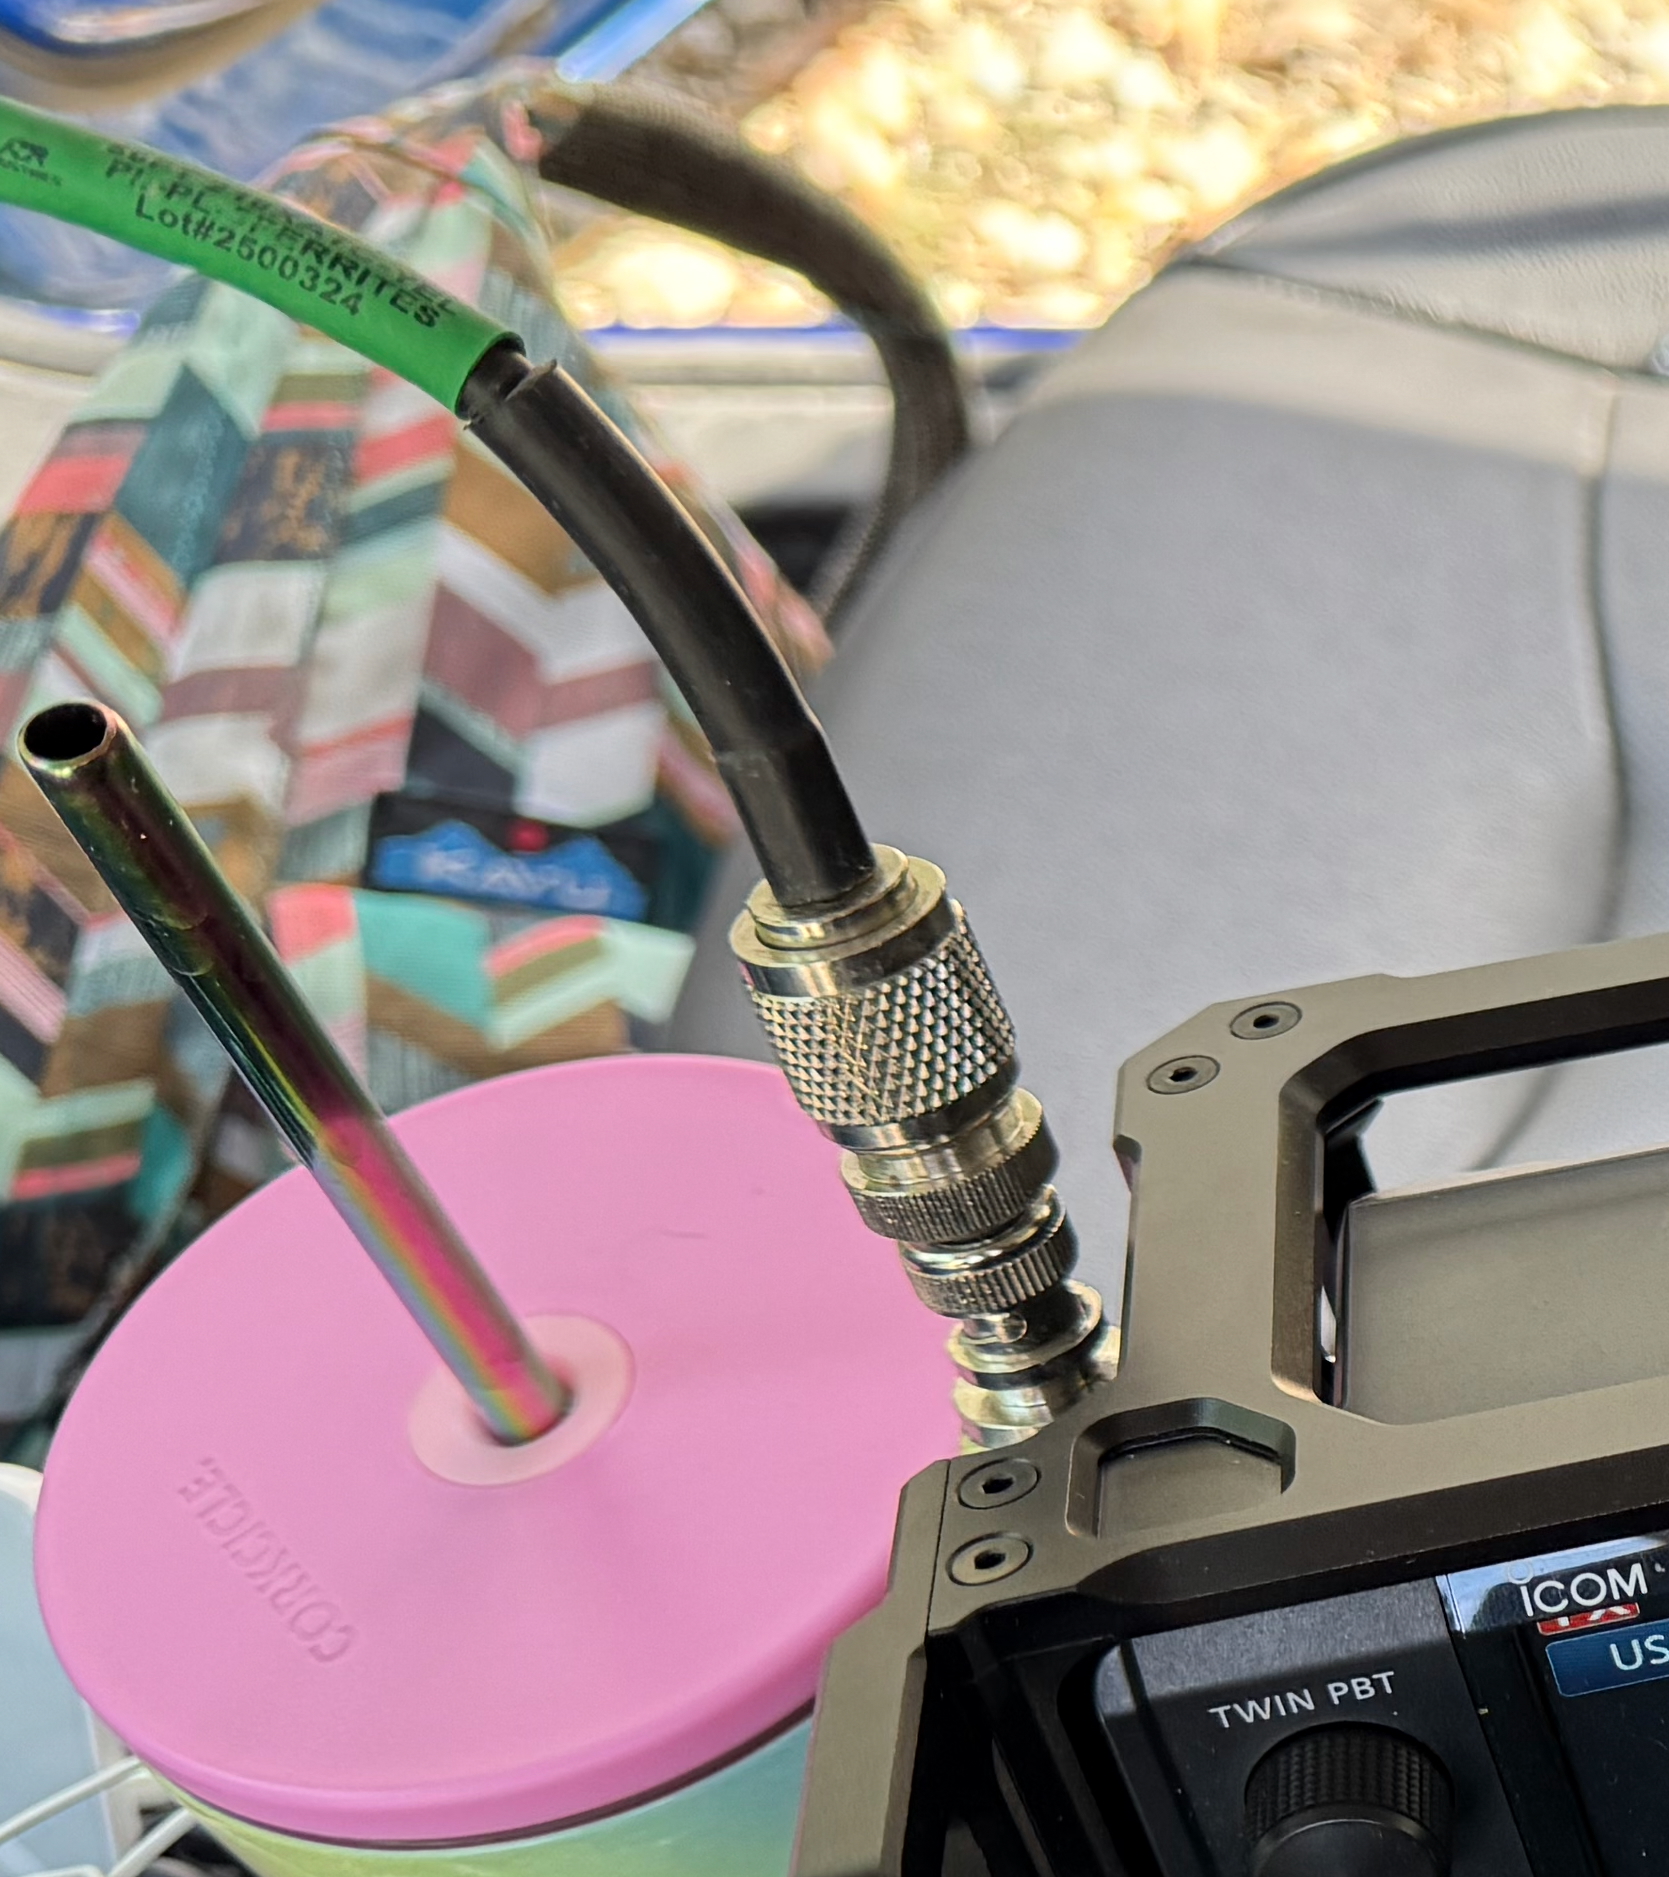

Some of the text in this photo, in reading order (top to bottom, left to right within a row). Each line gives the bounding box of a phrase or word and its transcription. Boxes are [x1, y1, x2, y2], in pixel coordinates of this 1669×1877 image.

[134, 193, 362, 318] Lot#2500324
[1207, 1671, 1397, 1730] TWIN PBT
